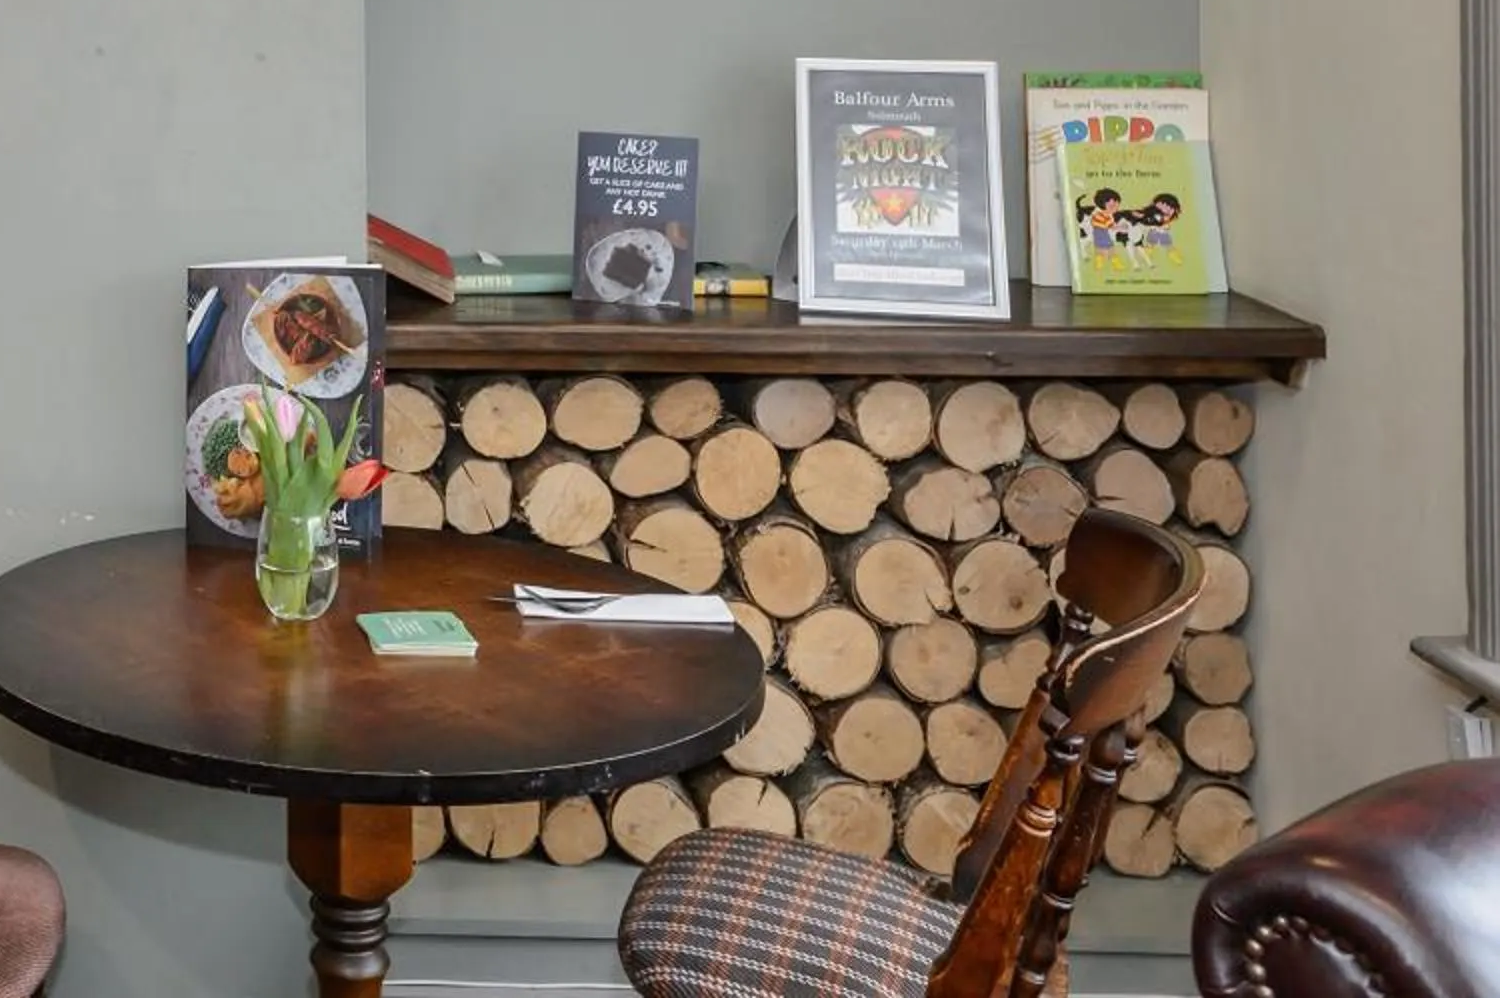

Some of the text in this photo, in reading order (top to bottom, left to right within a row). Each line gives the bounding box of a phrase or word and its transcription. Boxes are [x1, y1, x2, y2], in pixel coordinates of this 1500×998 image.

[835, 90, 955, 108] Balfour Arms
[613, 158, 672, 176] DESERVE
[612, 198, 658, 216] £4.95
